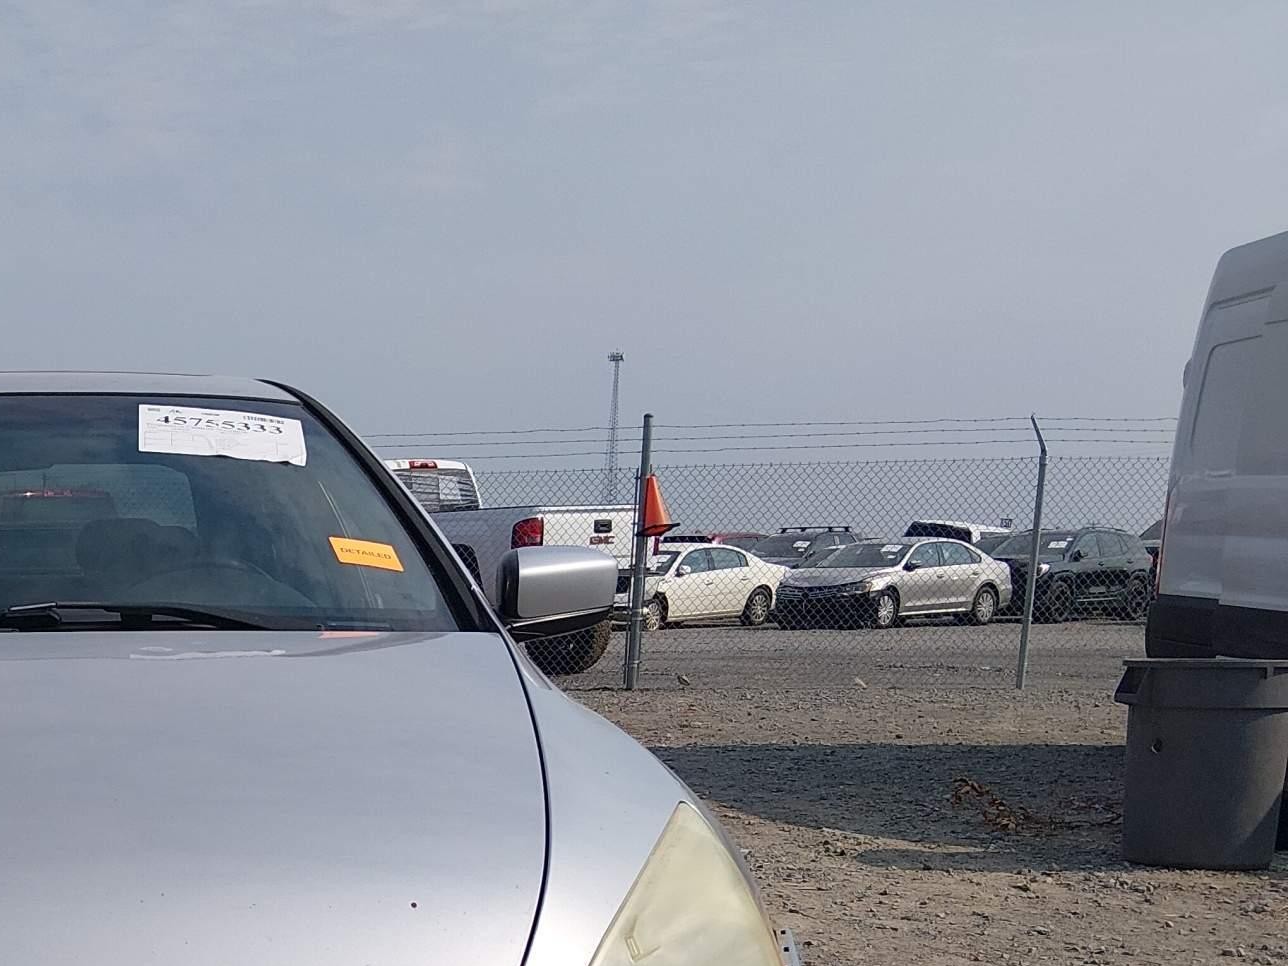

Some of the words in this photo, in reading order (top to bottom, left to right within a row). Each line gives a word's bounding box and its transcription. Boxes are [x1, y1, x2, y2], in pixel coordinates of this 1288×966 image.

[156, 415, 284, 435] 45755333
[589, 535, 616, 545] GMC
[340, 547, 392, 560] DETAILED
